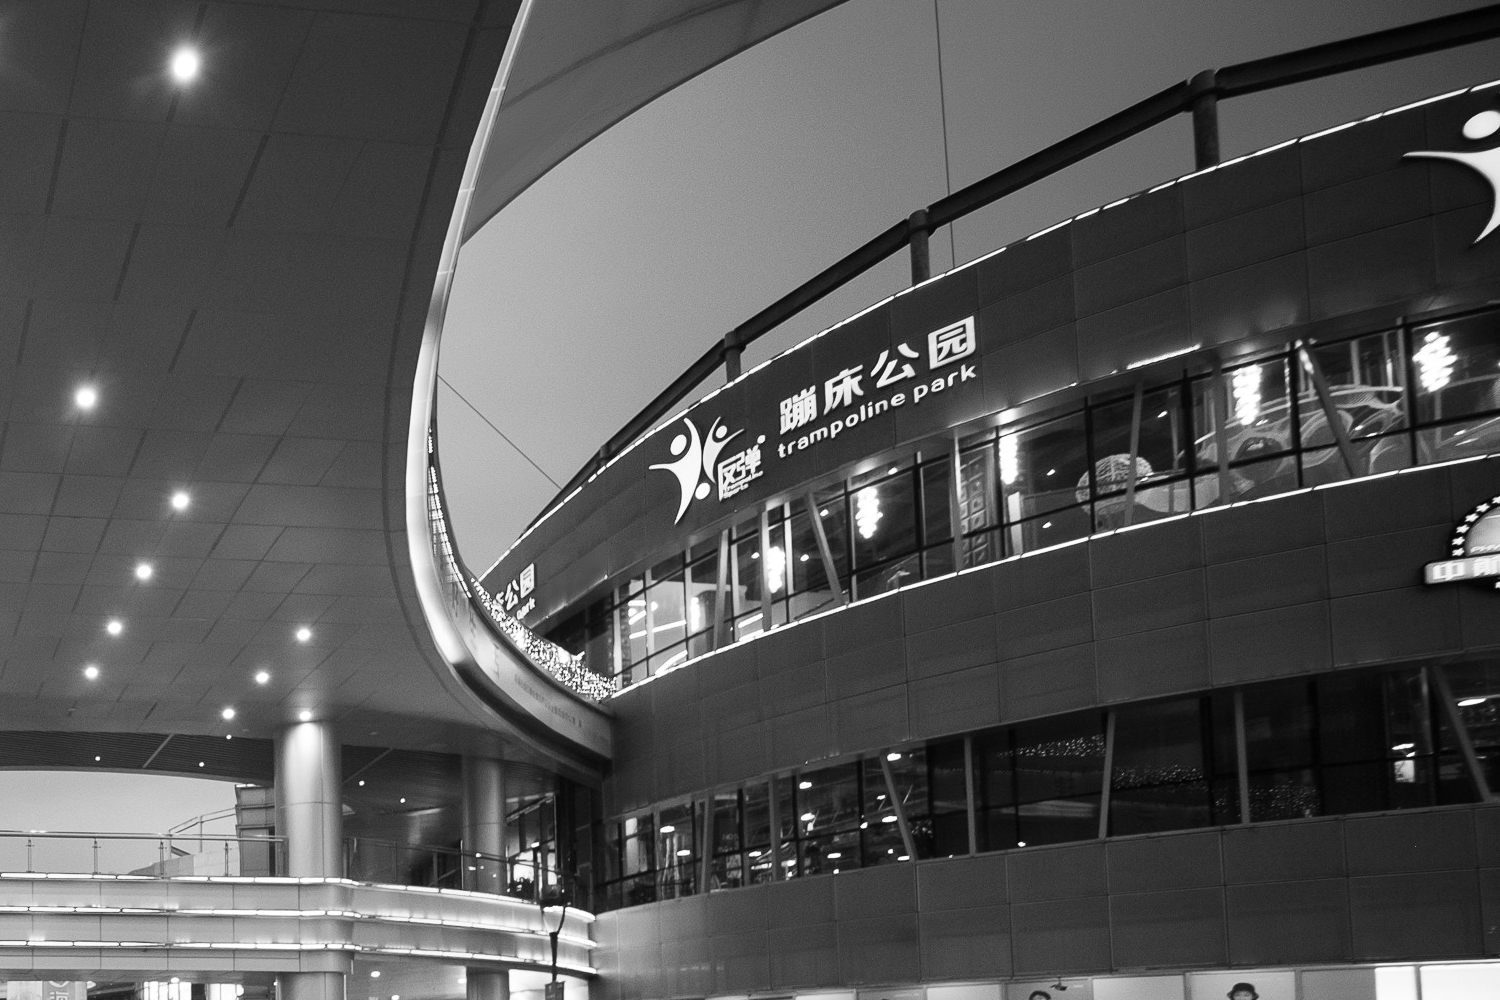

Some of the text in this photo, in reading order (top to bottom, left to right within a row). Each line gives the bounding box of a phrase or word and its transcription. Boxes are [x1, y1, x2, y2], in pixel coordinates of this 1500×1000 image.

[777, 363, 977, 459] trampoline park
[779, 315, 977, 435] 蹦床公园
